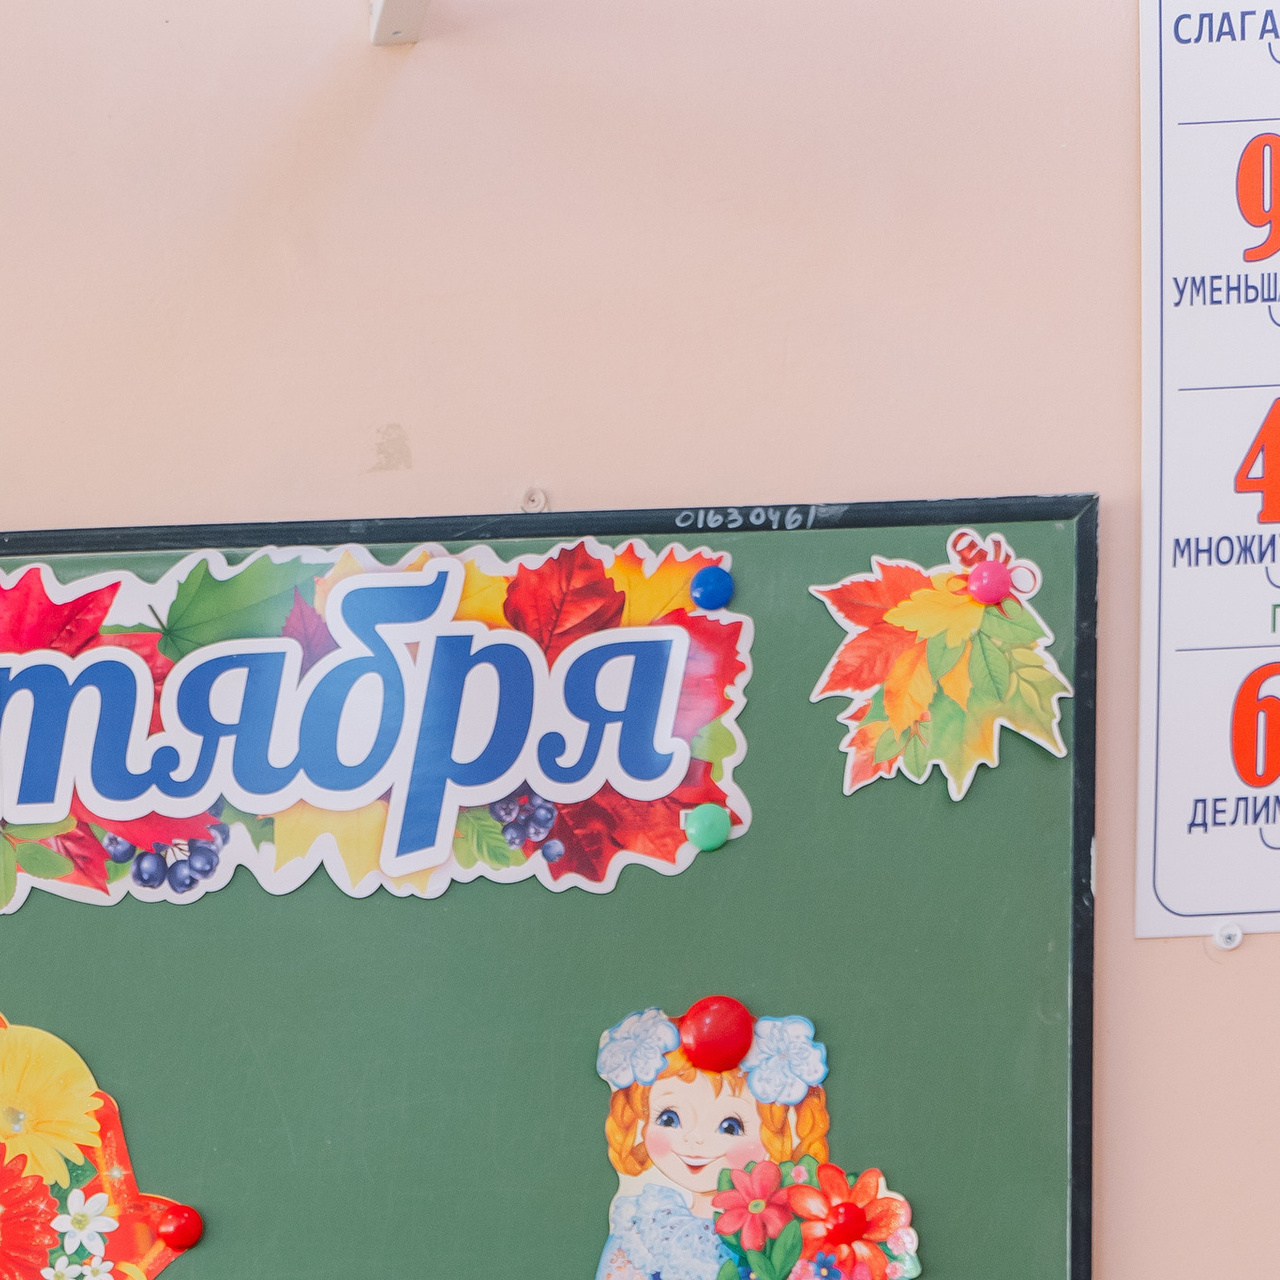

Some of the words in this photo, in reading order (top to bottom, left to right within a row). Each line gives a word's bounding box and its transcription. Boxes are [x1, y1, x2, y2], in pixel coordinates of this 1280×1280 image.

[1173, 9, 1280, 44] СЛАГА
[1236, 132, 1280, 262] 9
[1172, 272, 1280, 307] УМЕНЬШ
[1234, 397, 1280, 524] 4
[1172, 534, 1280, 568] МНОЖИ
[1230, 661, 1280, 788] 6
